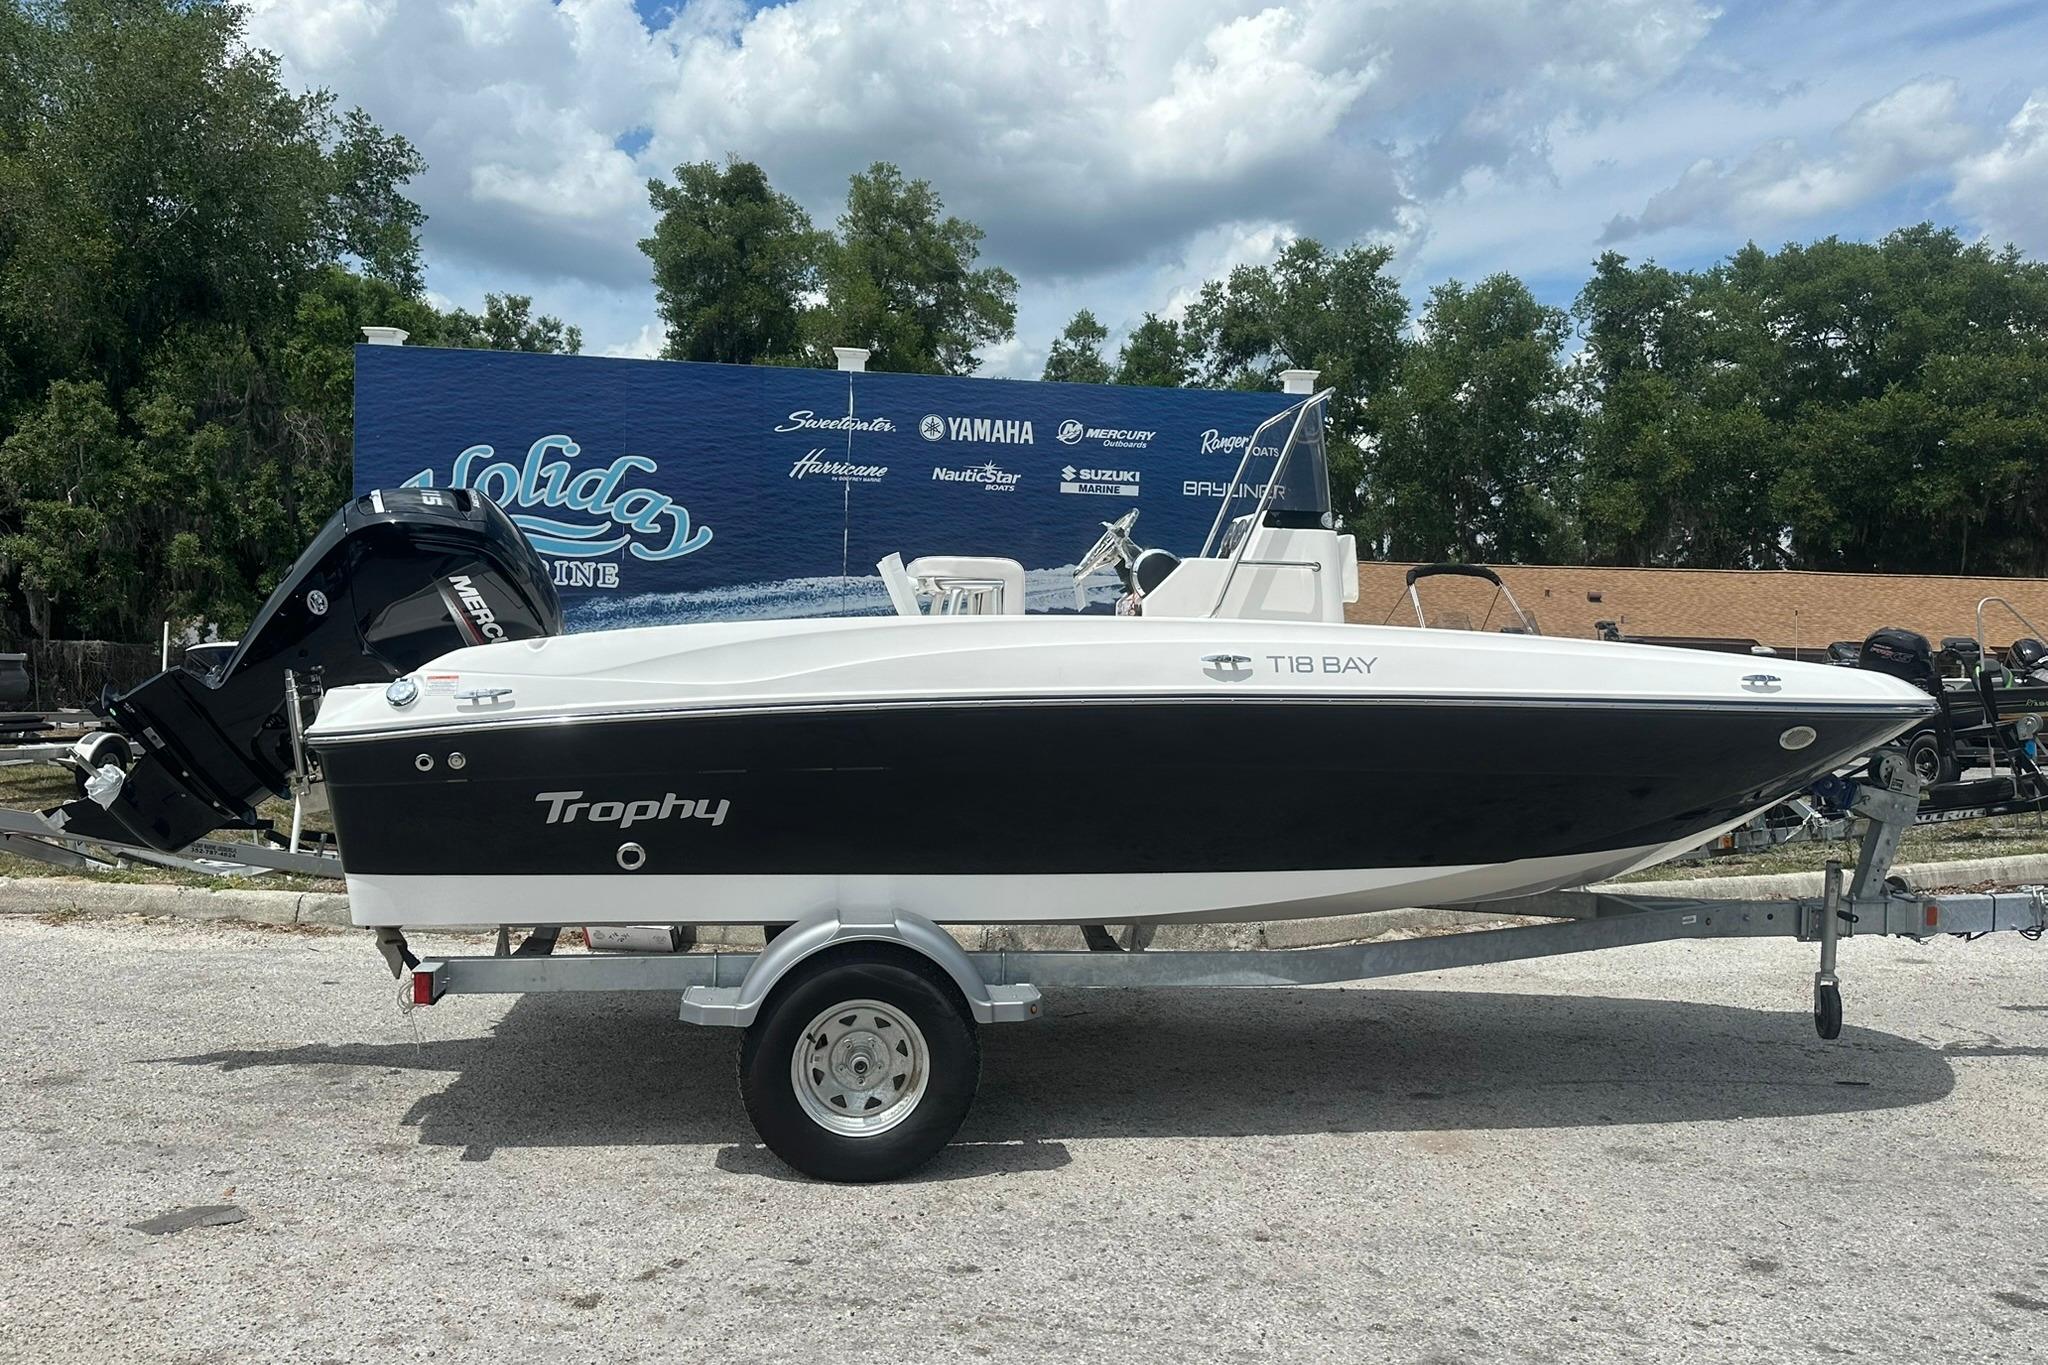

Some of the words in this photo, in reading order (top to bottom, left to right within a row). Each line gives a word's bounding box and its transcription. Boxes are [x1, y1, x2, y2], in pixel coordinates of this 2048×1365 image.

[948, 416, 1034, 445] YAMAHA
[1085, 428, 1157, 441] MERCURY
[1103, 438, 1147, 449] Outboards
[1200, 428, 1250, 455] Ranger
[1245, 446, 1280, 458] OATS
[789, 447, 888, 480] Hurricane
[932, 466, 1021, 485] NauticStar
[1079, 469, 1140, 482] SUZUKI
[984, 484, 1015, 492] BOATS
[1078, 484, 1121, 495] MARINE
[1266, 655, 1314, 673] T18
[1322, 656, 1378, 674] BAY
[535, 790, 731, 828] Trophy
